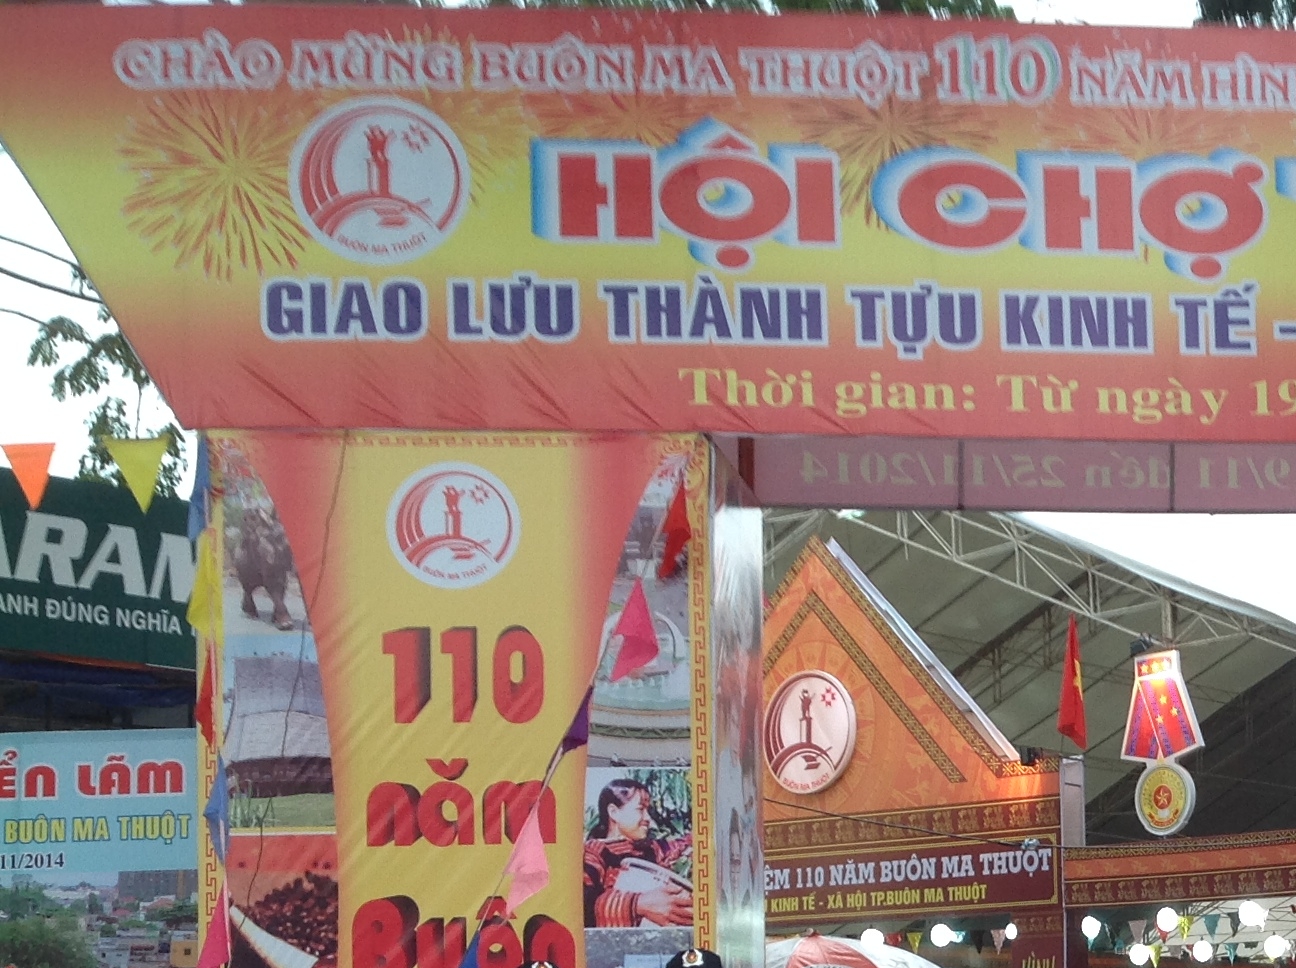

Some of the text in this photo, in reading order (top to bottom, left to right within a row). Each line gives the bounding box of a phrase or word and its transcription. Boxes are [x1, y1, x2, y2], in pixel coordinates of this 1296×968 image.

[115, 30, 285, 91] CHÀO
[290, 32, 464, 91] MỪNG
[471, 34, 635, 92] BUÔN
[641, 46, 735, 95] MA
[742, 40, 930, 106] THUỘT
[934, 35, 1060, 107] 110
[1071, 48, 1196, 110] NĂM
[531, 116, 842, 271] HỘI
[870, 146, 1268, 281] CHỢ
[372, 244, 389, 255] MA
[264, 278, 428, 343] GIAO
[446, 272, 582, 343] LƯU
[600, 273, 830, 345] THÀNH
[848, 279, 984, 359] TỰU
[1002, 290, 1153, 354] KINH
[1171, 280, 1259, 357] TẾ
[679, 366, 812, 409] Thời
[835, 376, 976, 421] gian:
[997, 374, 1080, 414] Từ
[1095, 378, 1229, 424] ngày
[115, 607, 183, 636] NGHĨA
[383, 625, 544, 724] 110
[77, 754, 184, 796] LÃM
[4, 809, 192, 845] BUÔN MA THUỘT
[797, 866, 824, 888] 110
[829, 859, 875, 886] NĂM
[880, 853, 936, 882] BUÔN
[941, 855, 975, 878] MA
[980, 848, 1052, 878] THUỘT
[771, 896, 799, 912] KINH
[802, 891, 816, 911] TẾ
[847, 889, 866, 911] HỘI
[924, 887, 944, 903] MA
[947, 882, 987, 903] THUỘT
